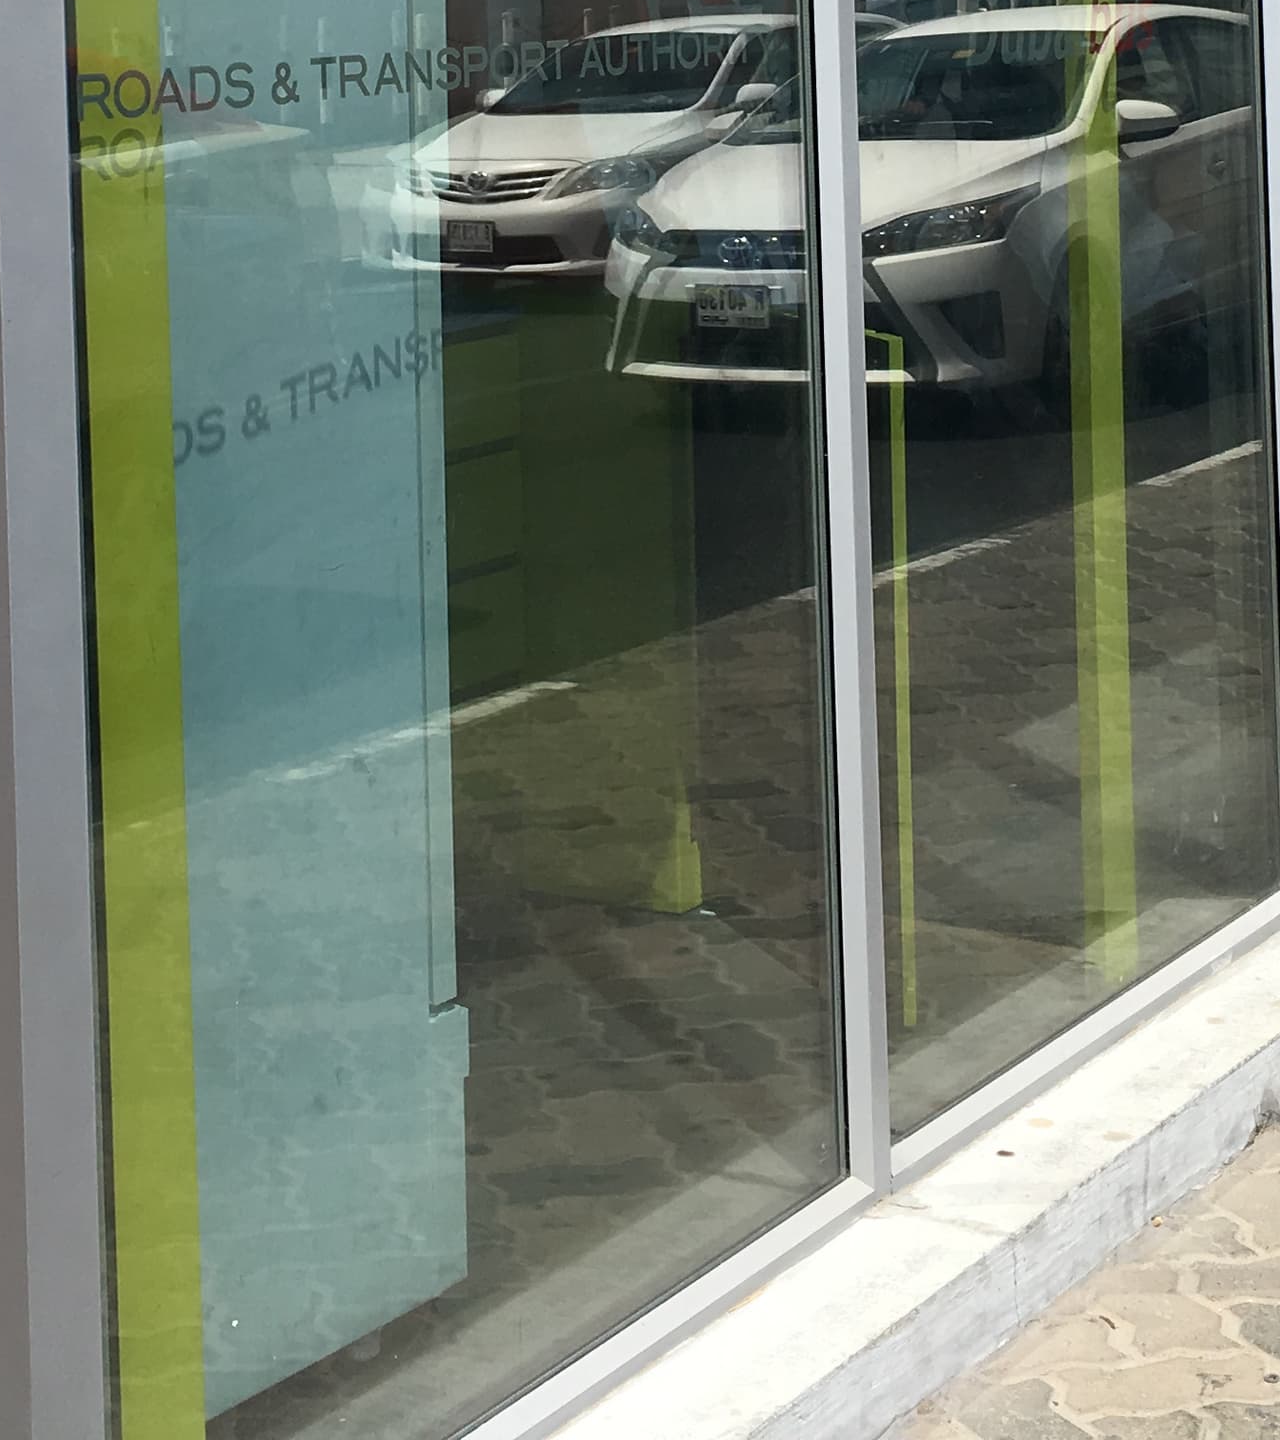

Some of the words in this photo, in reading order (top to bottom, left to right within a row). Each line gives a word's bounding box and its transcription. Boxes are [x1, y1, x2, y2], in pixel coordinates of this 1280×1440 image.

[76, 61, 255, 122] ROADS
[271, 62, 301, 105] &
[309, 38, 571, 101] TRANSPORT
